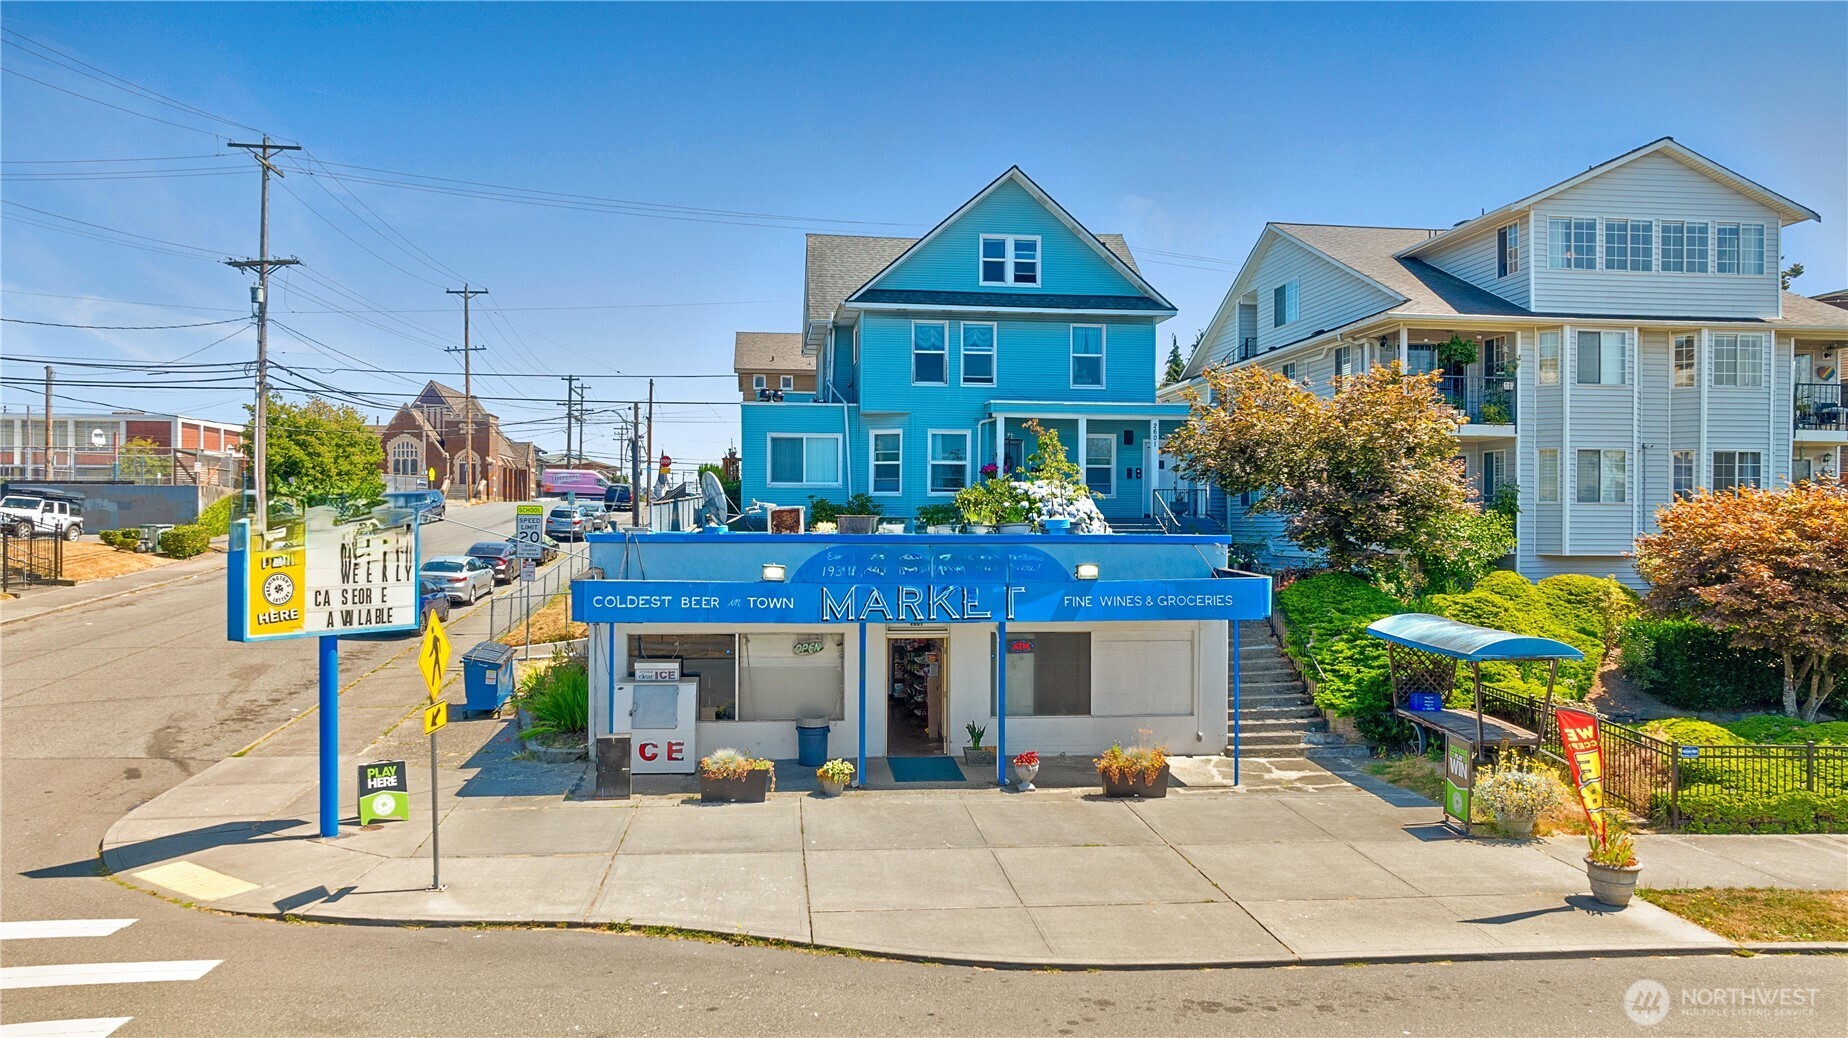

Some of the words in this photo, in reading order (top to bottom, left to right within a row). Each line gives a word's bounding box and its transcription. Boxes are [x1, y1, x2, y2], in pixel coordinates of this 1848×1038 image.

[519, 531, 540, 543] 20
[593, 596, 672, 608] COLDEST
[681, 597, 720, 608] BEER
[727, 598, 741, 608] in
[747, 597, 794, 609] TOWN
[1064, 595, 1093, 607] FINE
[1100, 595, 1142, 607] WINES
[1145, 596, 1154, 607] &
[1157, 595, 1233, 606] GROCERIES
[257, 608, 300, 625] HERE
[794, 641, 824, 654] OPEN
[1012, 641, 1030, 651] ATM
[654, 670, 676, 680] ICE
[638, 739, 685, 762] CE
[366, 765, 397, 779] PLAY
[1449, 756, 1468, 780] WIN
[367, 775, 398, 789] HERE
